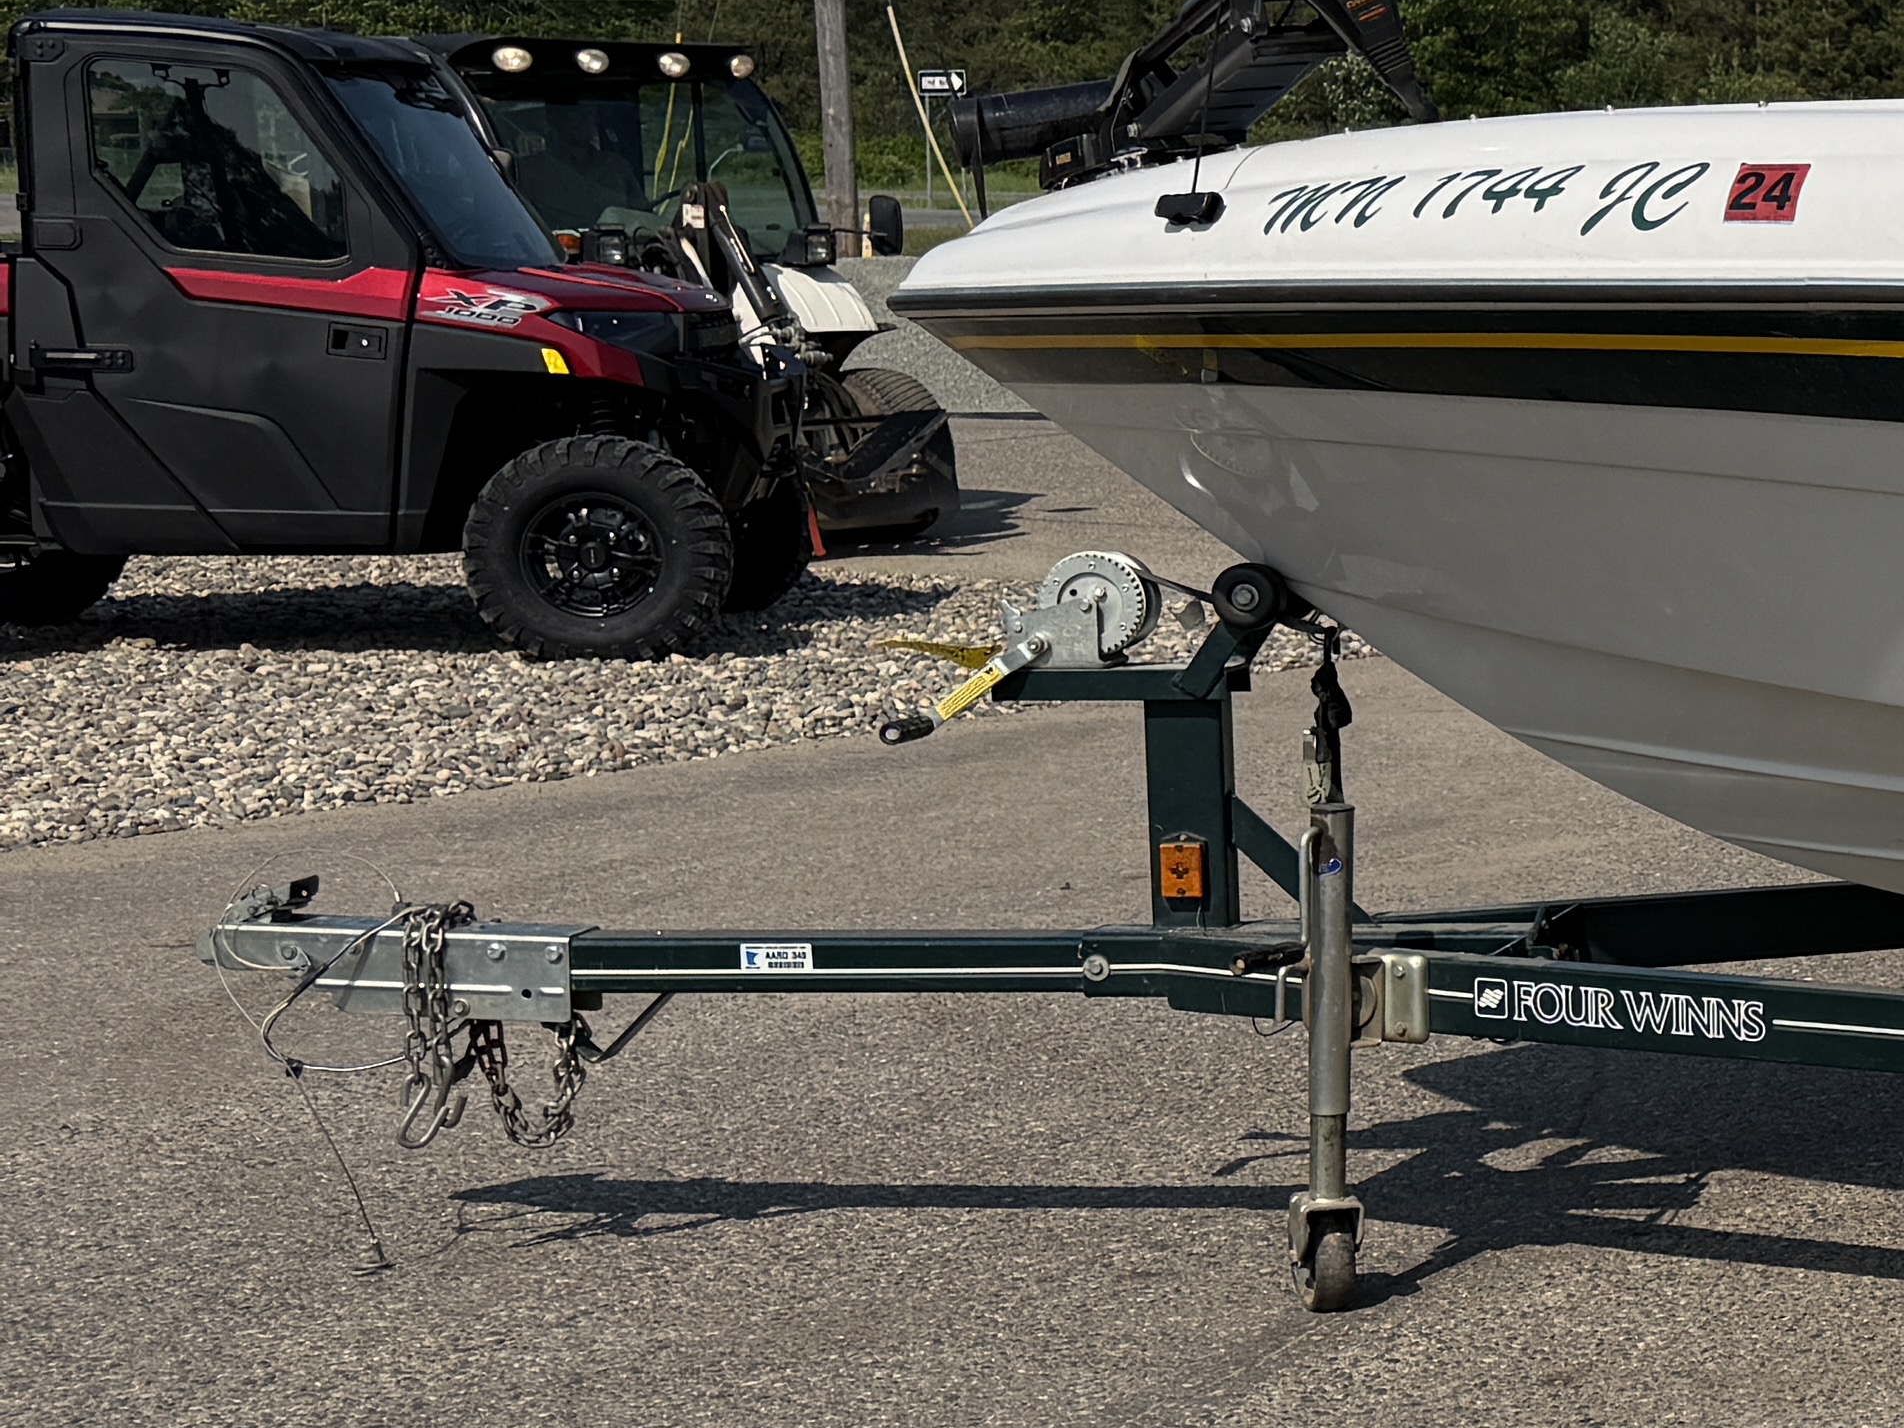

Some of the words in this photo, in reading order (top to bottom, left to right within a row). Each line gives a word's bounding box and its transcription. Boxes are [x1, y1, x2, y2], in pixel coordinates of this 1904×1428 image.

[1263, 175, 1406, 237] MN
[1412, 164, 1586, 220] 1744
[1729, 171, 1796, 212] 24
[432, 288, 538, 313] XP
[444, 306, 522, 326] 1000
[1513, 980, 1624, 1030] FOUR
[1620, 990, 1767, 1042] WINNS
